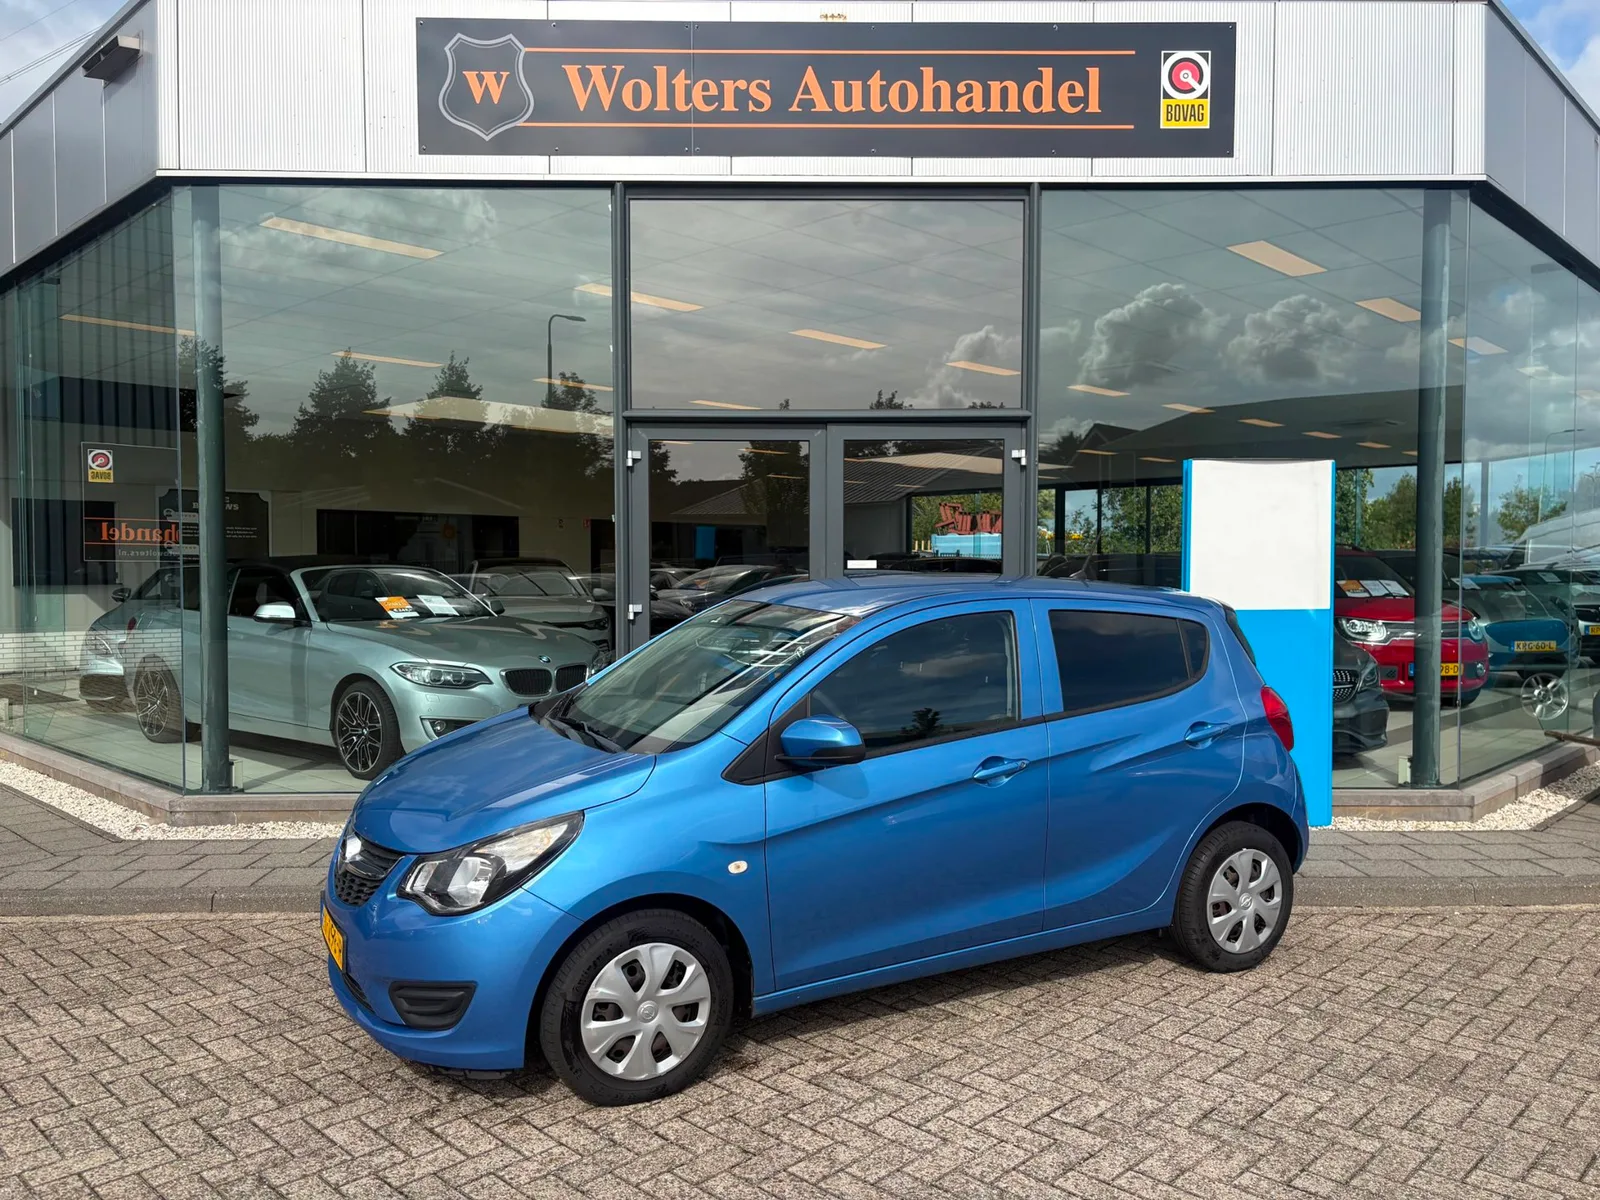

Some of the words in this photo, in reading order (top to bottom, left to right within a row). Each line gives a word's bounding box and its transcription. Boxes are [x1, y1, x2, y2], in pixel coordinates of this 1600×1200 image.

[462, 71, 509, 105] W
[561, 64, 773, 113] Wolters
[788, 65, 1102, 114] Autohandel
[1165, 103, 1205, 122] BOVAG
